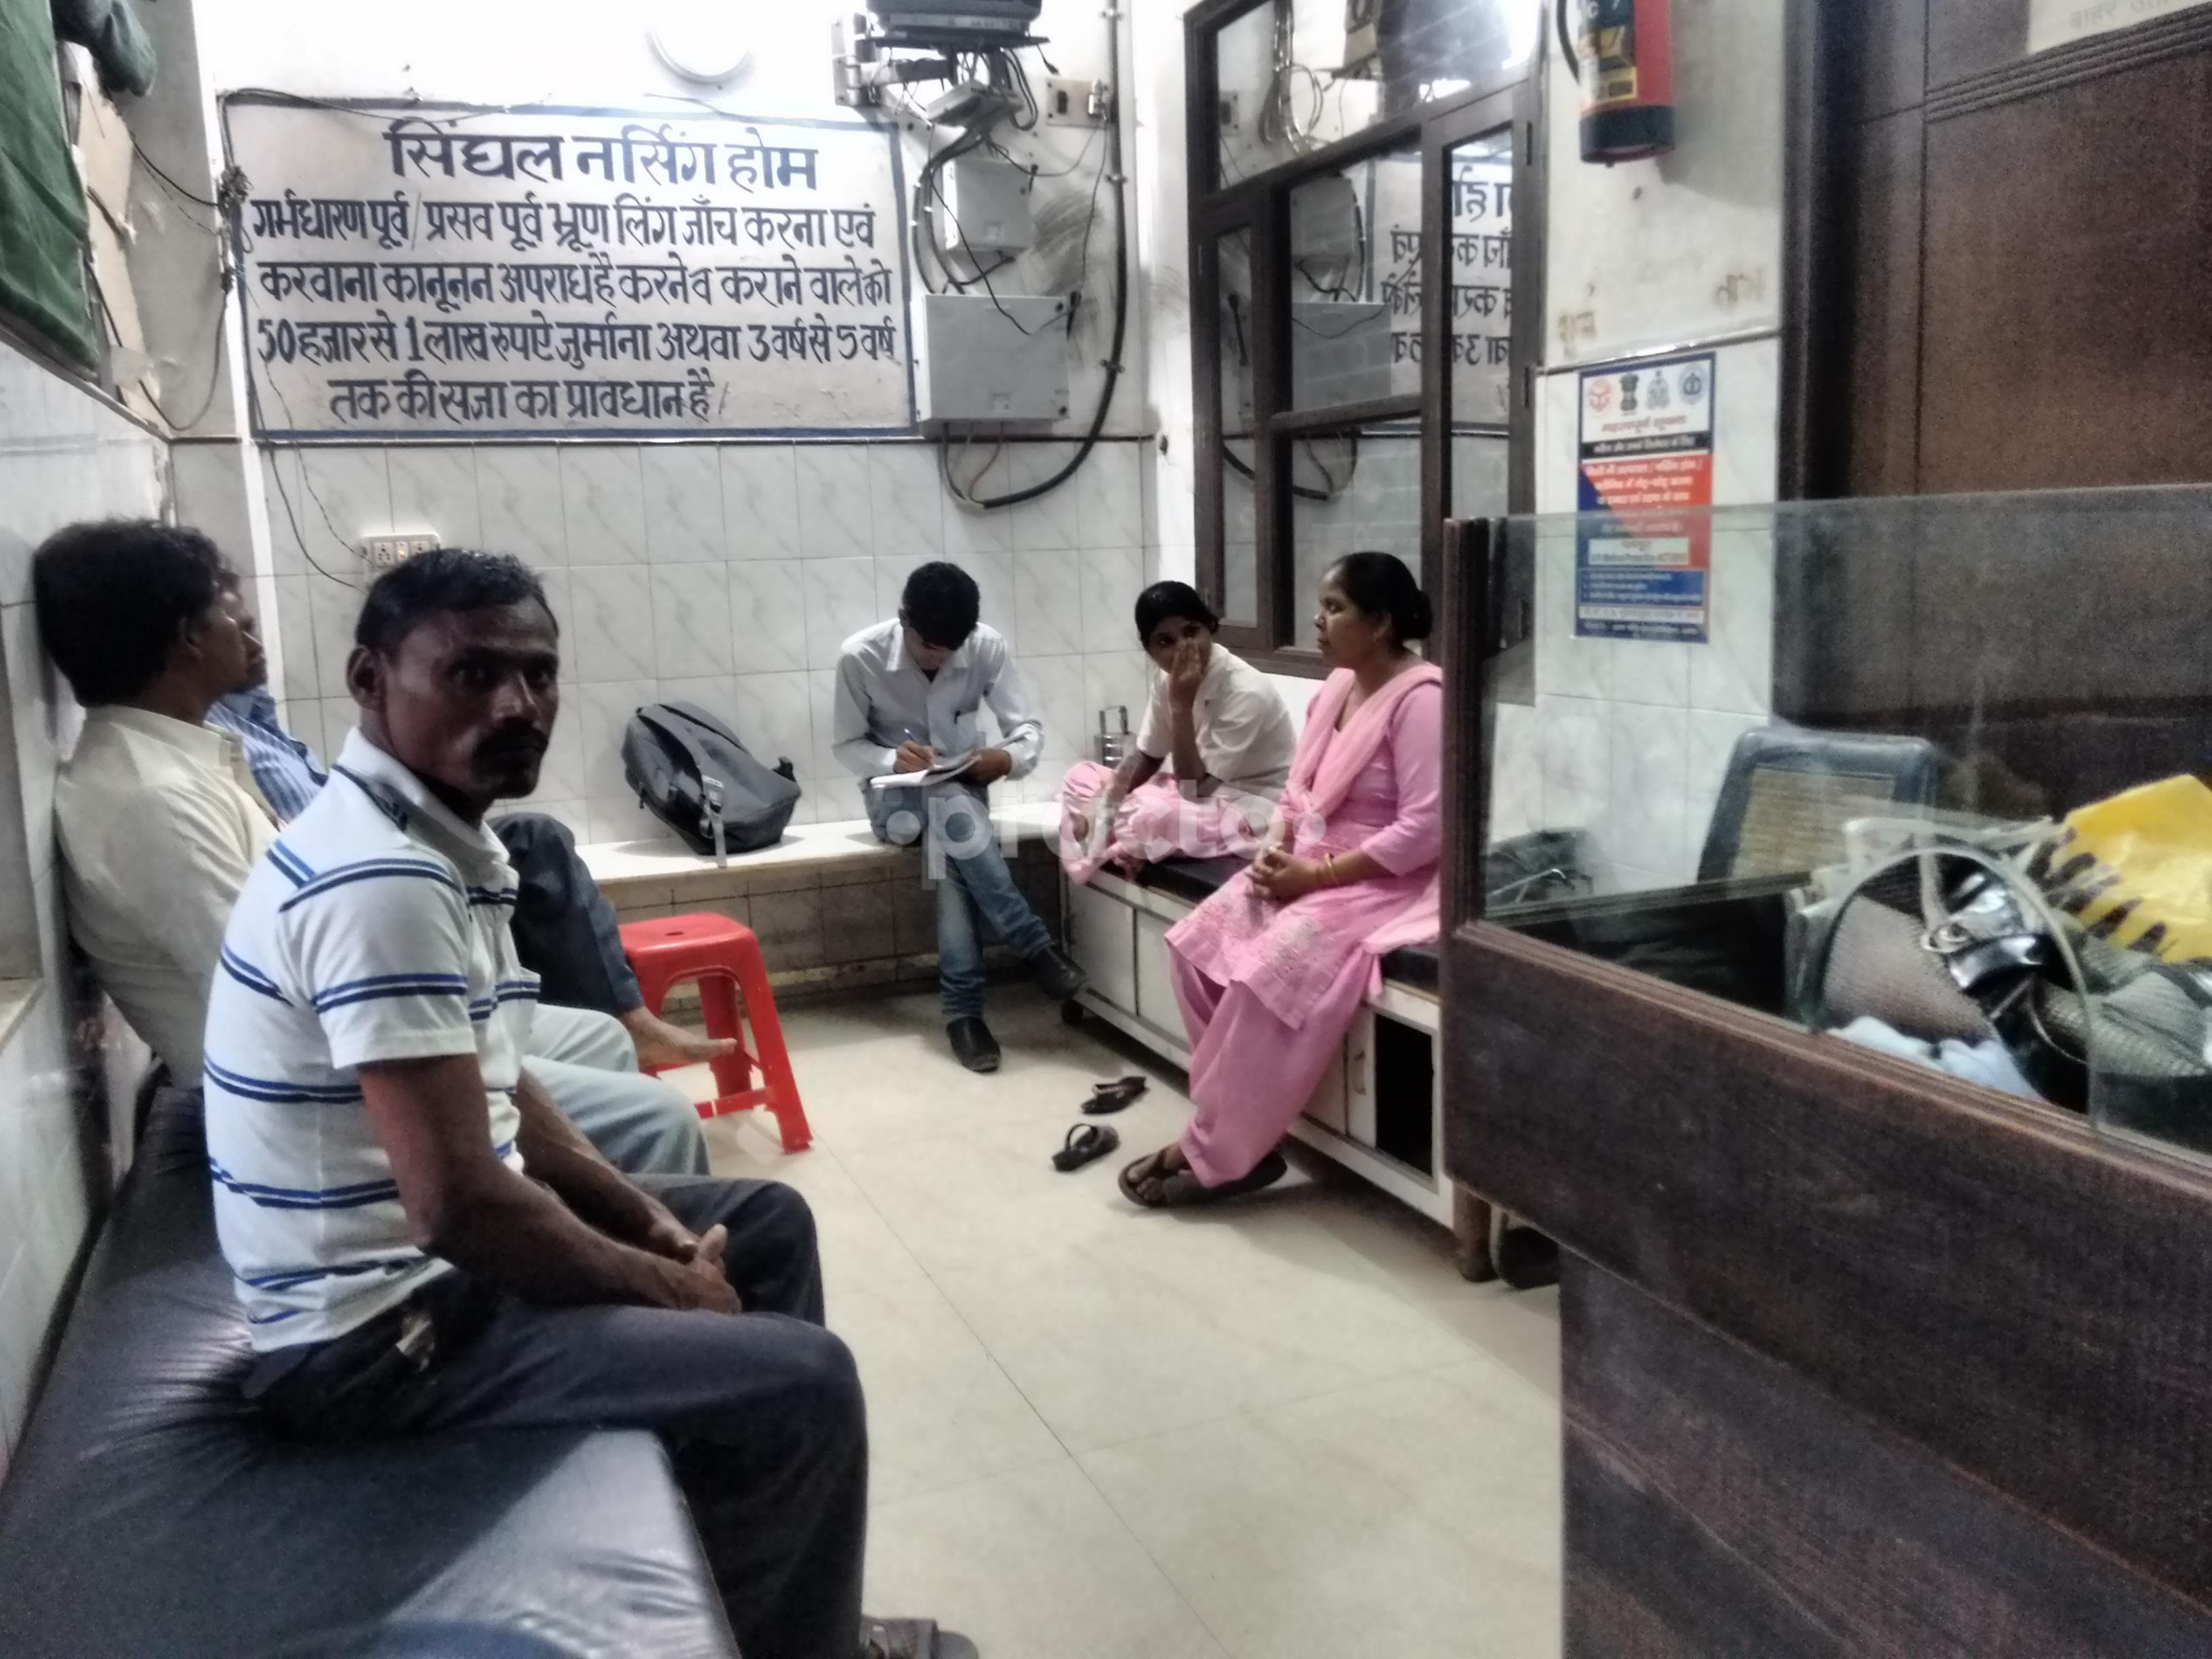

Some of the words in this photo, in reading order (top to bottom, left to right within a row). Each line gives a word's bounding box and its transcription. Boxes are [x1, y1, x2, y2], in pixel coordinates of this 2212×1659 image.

[382, 117, 565, 183] सिंघल
[571, 123, 717, 186] नर्सिंग
[724, 127, 819, 193] होम
[422, 201, 494, 242] प्रसव
[496, 190, 544, 251] पूर्व
[546, 202, 610, 252] भ्रूण
[613, 192, 678, 247] लिंग
[678, 194, 737, 246] जाँच
[741, 207, 829, 249] करना
[830, 202, 876, 249] एवं
[256, 261, 377, 303] करवाना
[380, 262, 494, 312] कानूनन
[497, 263, 594, 304] अपराध
[588, 252, 617, 308] है
[615, 251, 689, 306] करने
[689, 268, 713, 306] व
[715, 253, 803, 308] कराने
[804, 254, 864, 307] वाले
[862, 258, 893, 307] को
[258, 319, 295, 364] 50
[366, 309, 399, 363] से
[405, 316, 424, 361] 1
[424, 321, 487, 365] लाख
[555, 311, 653, 370] जुर्माना
[657, 323, 743, 361] अथवा
[747, 324, 770, 362] 3
[771, 316, 807, 361] वर्ष
[808, 312, 833, 364] से
[836, 325, 858, 360] 5
[860, 315, 897, 361] वर्ष
[327, 380, 391, 425] तक
[391, 368, 437, 419] की
[438, 380, 509, 425] सजा
[510, 380, 561, 420] का
[562, 380, 686, 419] प्रावधान
